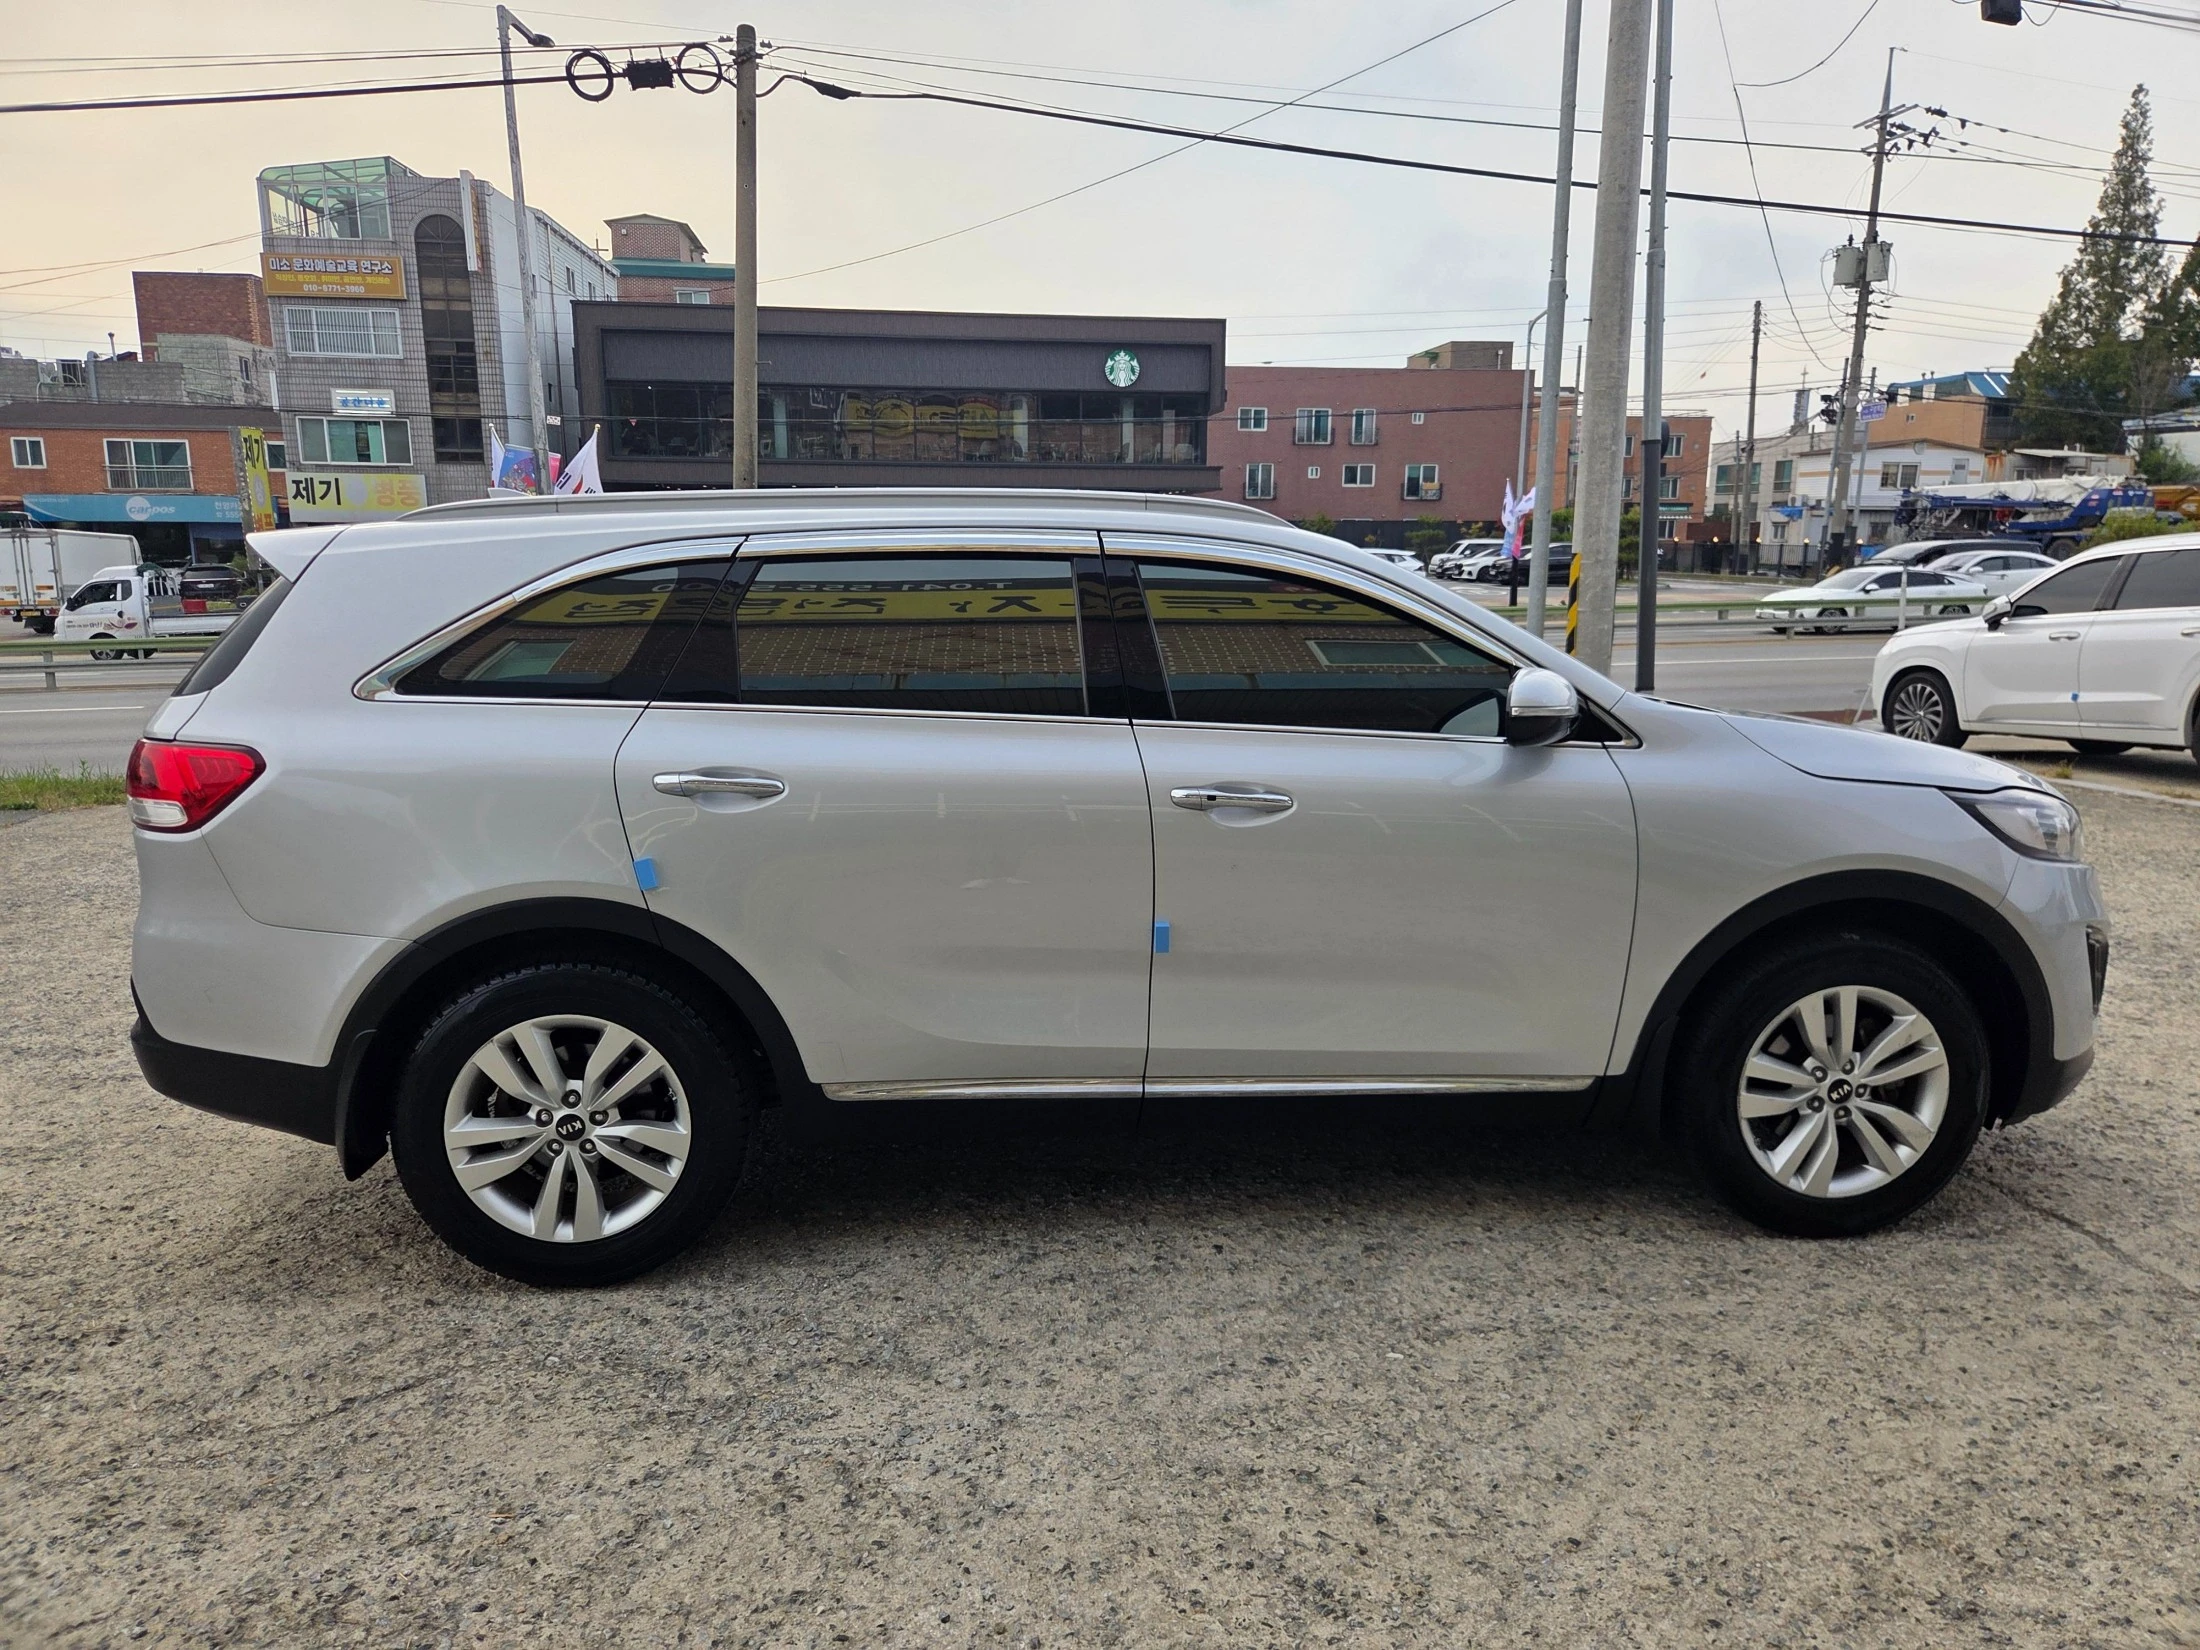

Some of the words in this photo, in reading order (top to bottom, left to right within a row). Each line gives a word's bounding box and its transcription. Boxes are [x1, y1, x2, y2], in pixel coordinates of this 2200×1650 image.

[269, 257, 291, 271] 미소
[293, 258, 358, 273] 문화예술교육
[361, 260, 393, 274] 연구소
[243, 434, 267, 470] 제기
[291, 477, 342, 506] 제기
[1830, 1084, 1852, 1101] KIA
[557, 1120, 582, 1135] KIA
